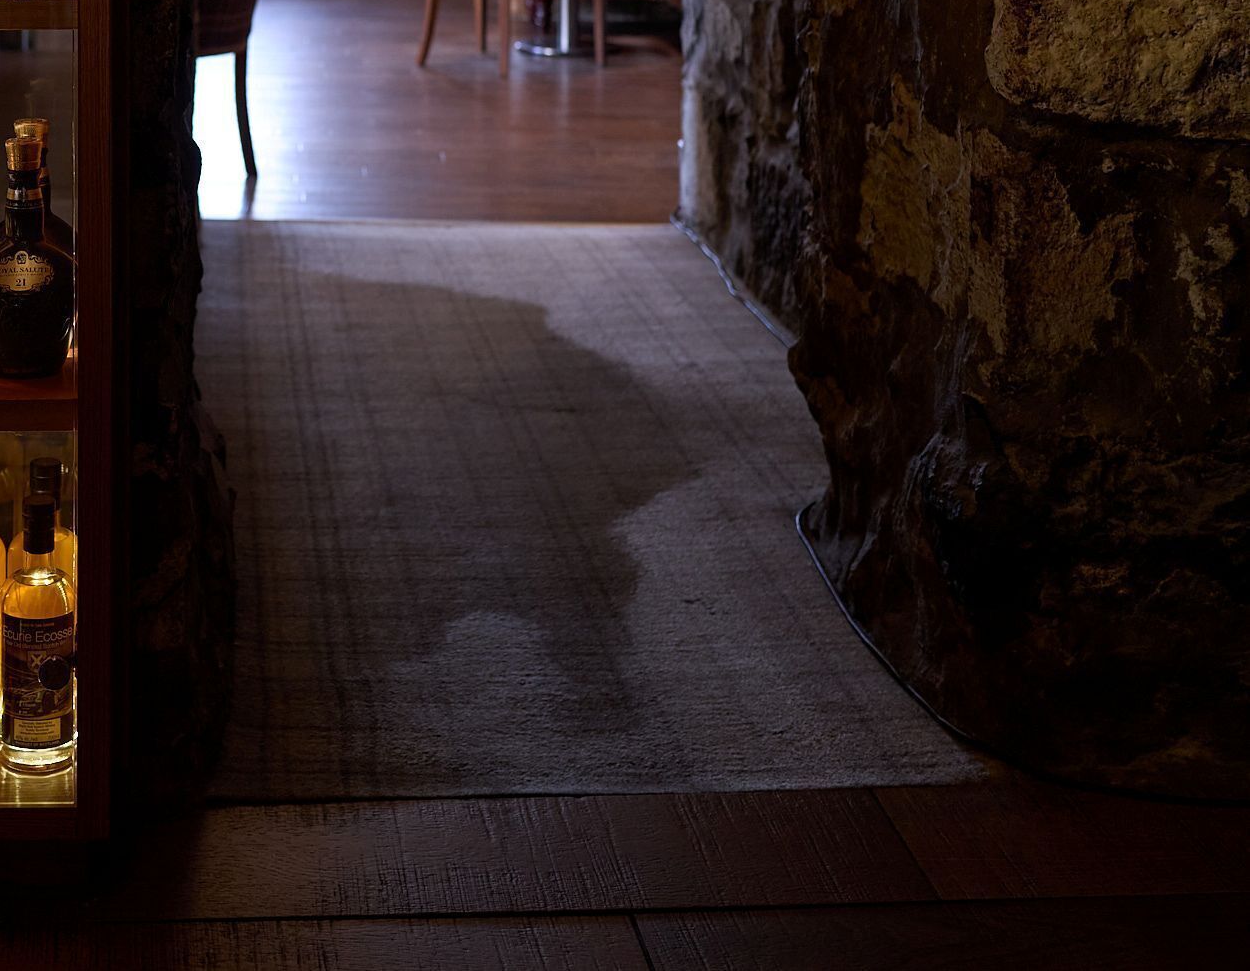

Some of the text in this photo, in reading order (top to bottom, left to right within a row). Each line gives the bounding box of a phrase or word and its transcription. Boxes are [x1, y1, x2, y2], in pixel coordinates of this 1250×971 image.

[15, 278, 26, 286] 21
[2, 625, 73, 643] Ecurie Ecosse
